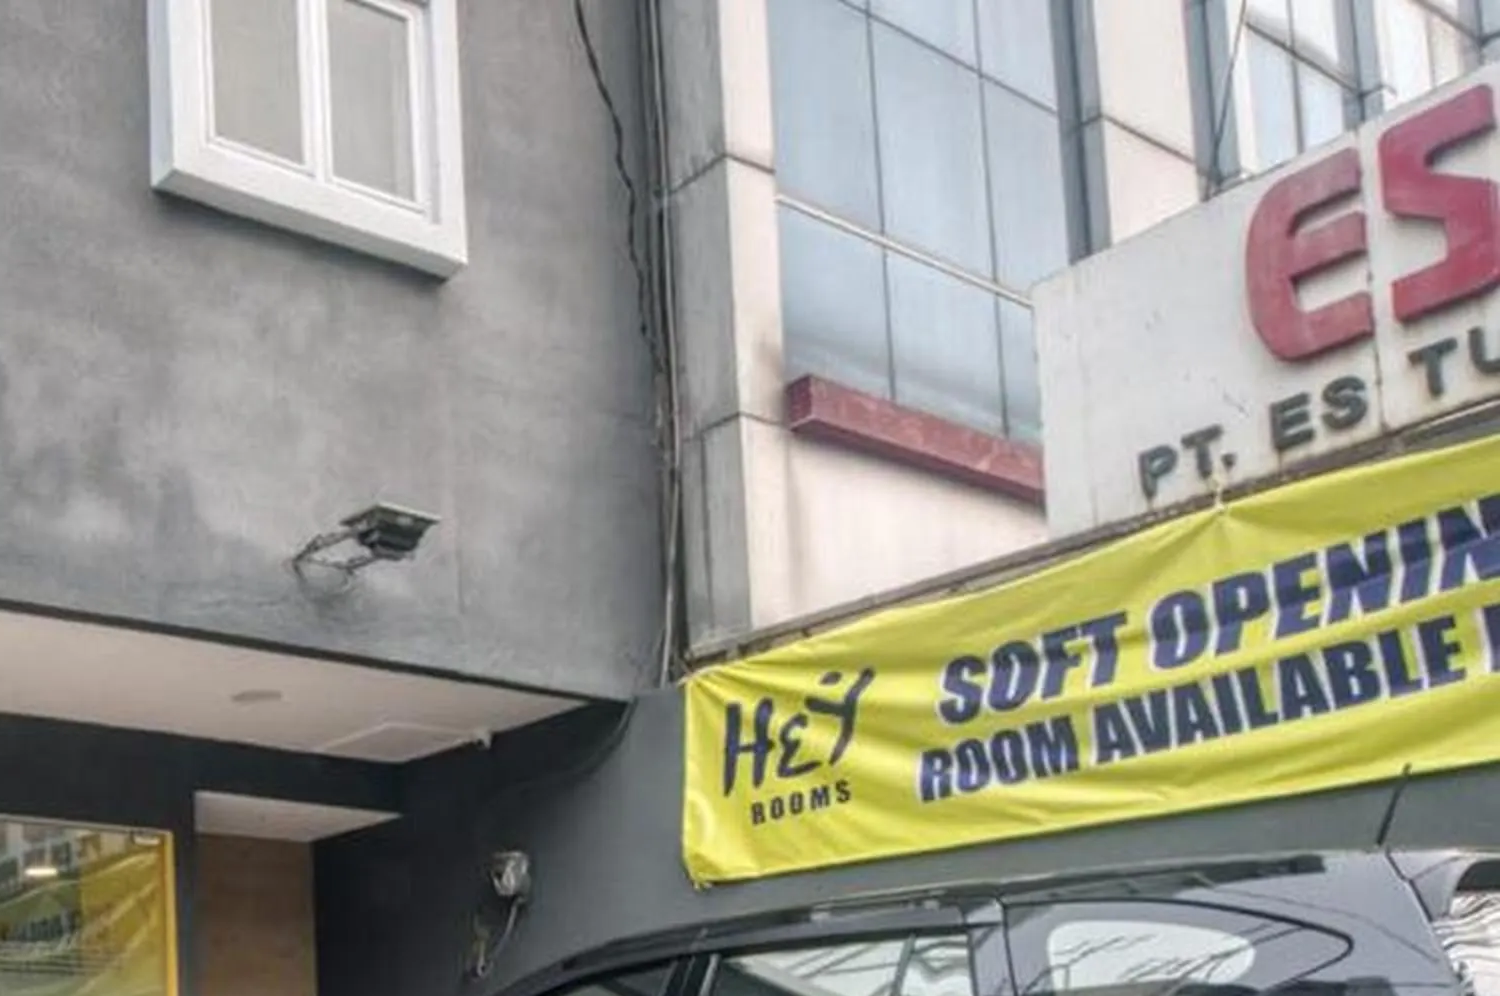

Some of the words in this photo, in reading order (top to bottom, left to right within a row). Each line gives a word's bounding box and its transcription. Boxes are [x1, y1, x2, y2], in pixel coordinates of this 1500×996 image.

[1137, 423, 1237, 500] PT.
[1269, 375, 1369, 452] ES
[918, 713, 1080, 803] ROOM
[1092, 613, 1467, 766] AVAILABLE
[936, 608, 1128, 725] SOFT
[751, 779, 852, 826] ROOMS
